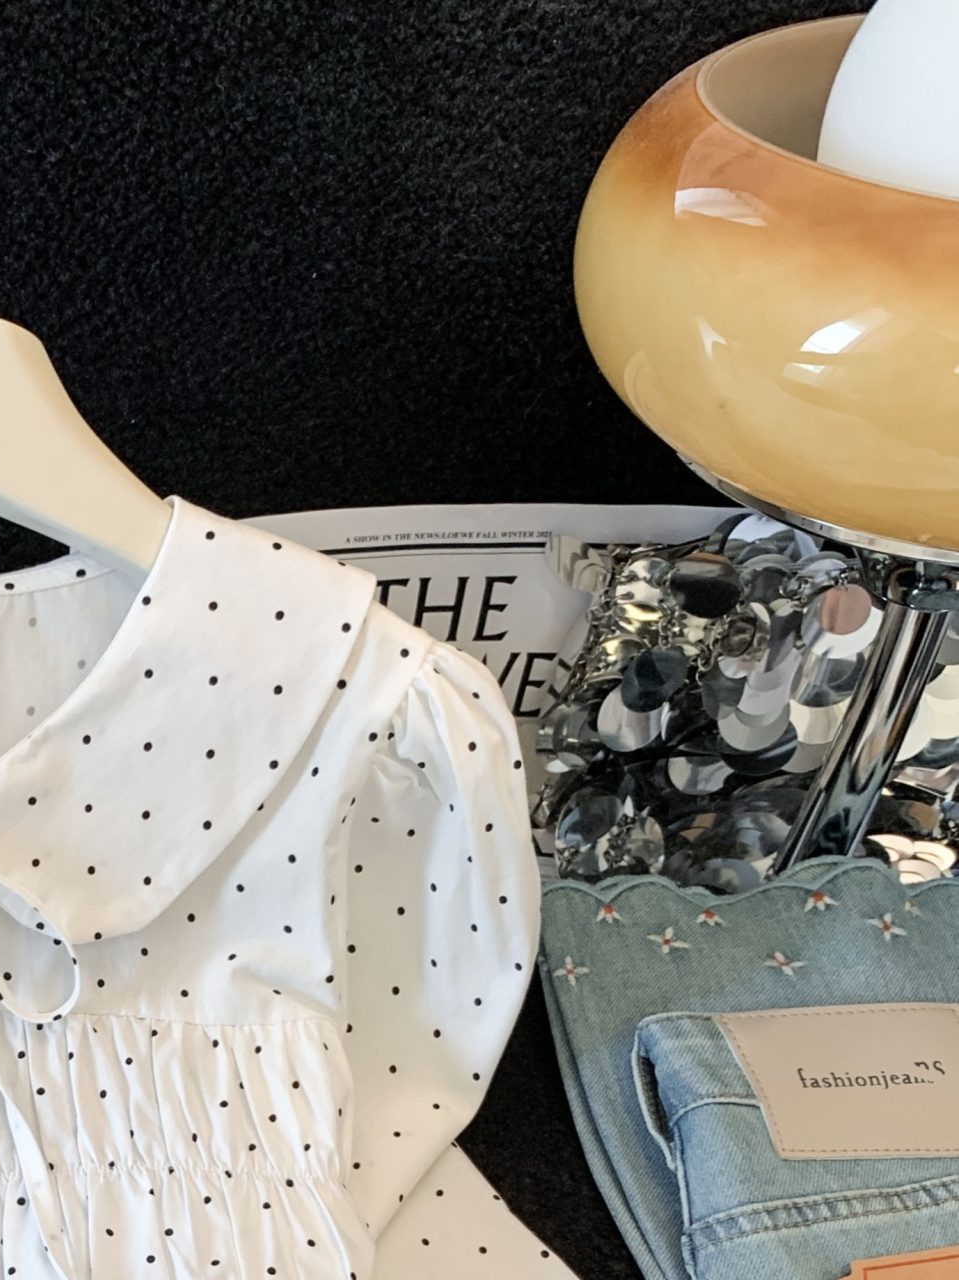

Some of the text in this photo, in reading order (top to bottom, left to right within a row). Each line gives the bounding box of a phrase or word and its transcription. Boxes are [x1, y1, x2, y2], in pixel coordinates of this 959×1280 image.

[352, 534, 380, 543] SHOW
[382, 533, 392, 542] IN
[394, 532, 411, 541] THE
[476, 531, 498, 539] FALL
[499, 530, 535, 538] WINTER
[376, 575, 518, 641] THE
